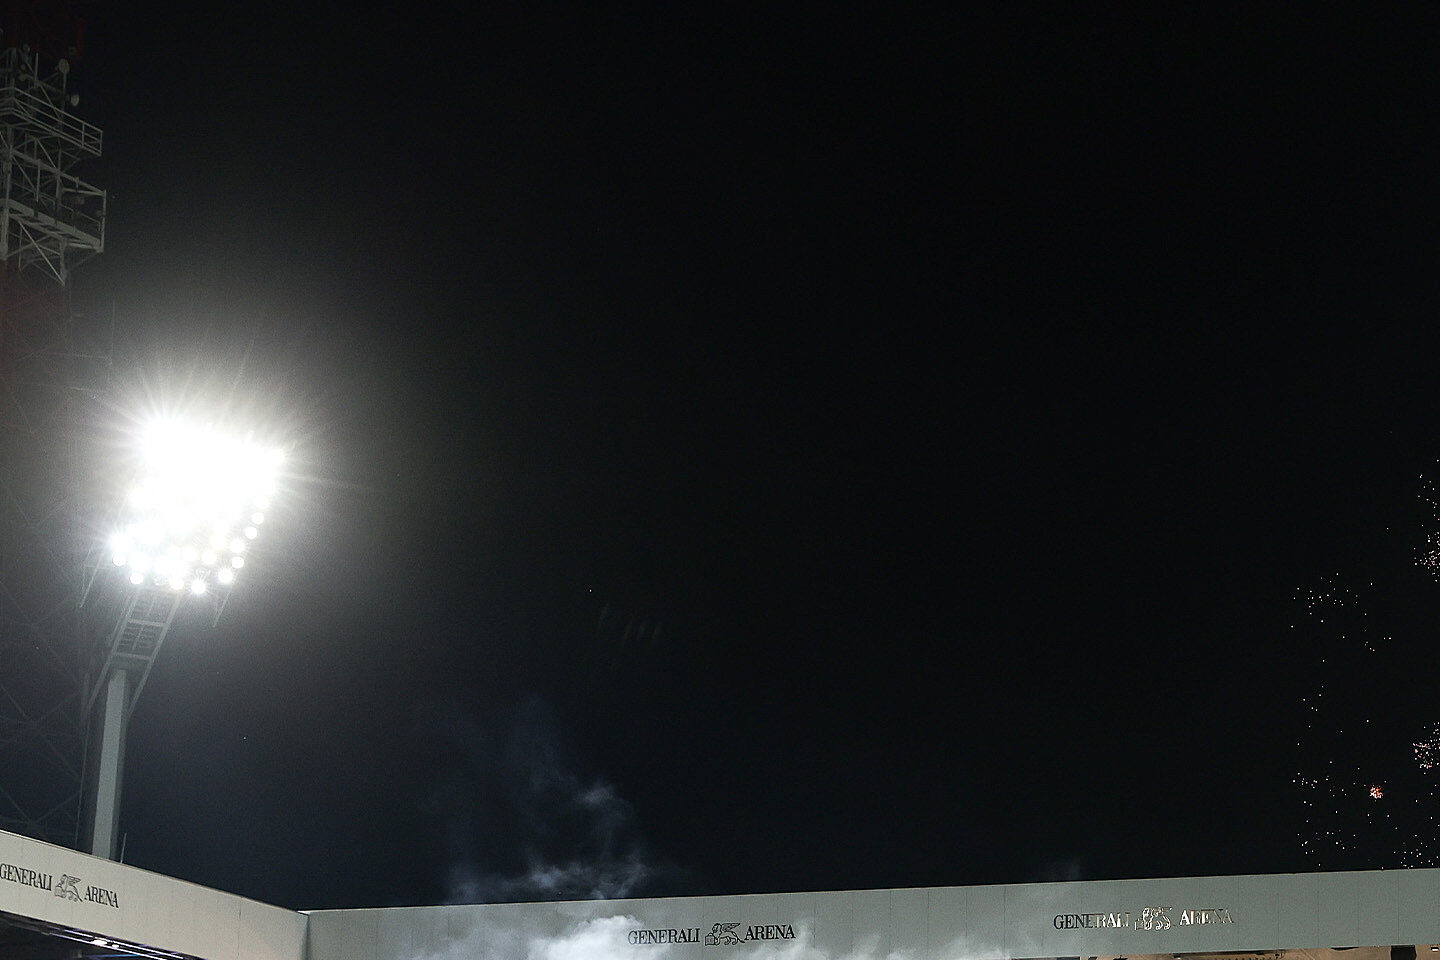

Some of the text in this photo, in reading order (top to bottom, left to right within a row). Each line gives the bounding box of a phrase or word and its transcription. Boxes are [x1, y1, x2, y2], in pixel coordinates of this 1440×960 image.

[0, 863, 119, 909] GENERALI ARENA
[1053, 908, 1235, 930] GENERALI ARENA
[627, 924, 796, 945] GENERALI ARENA
